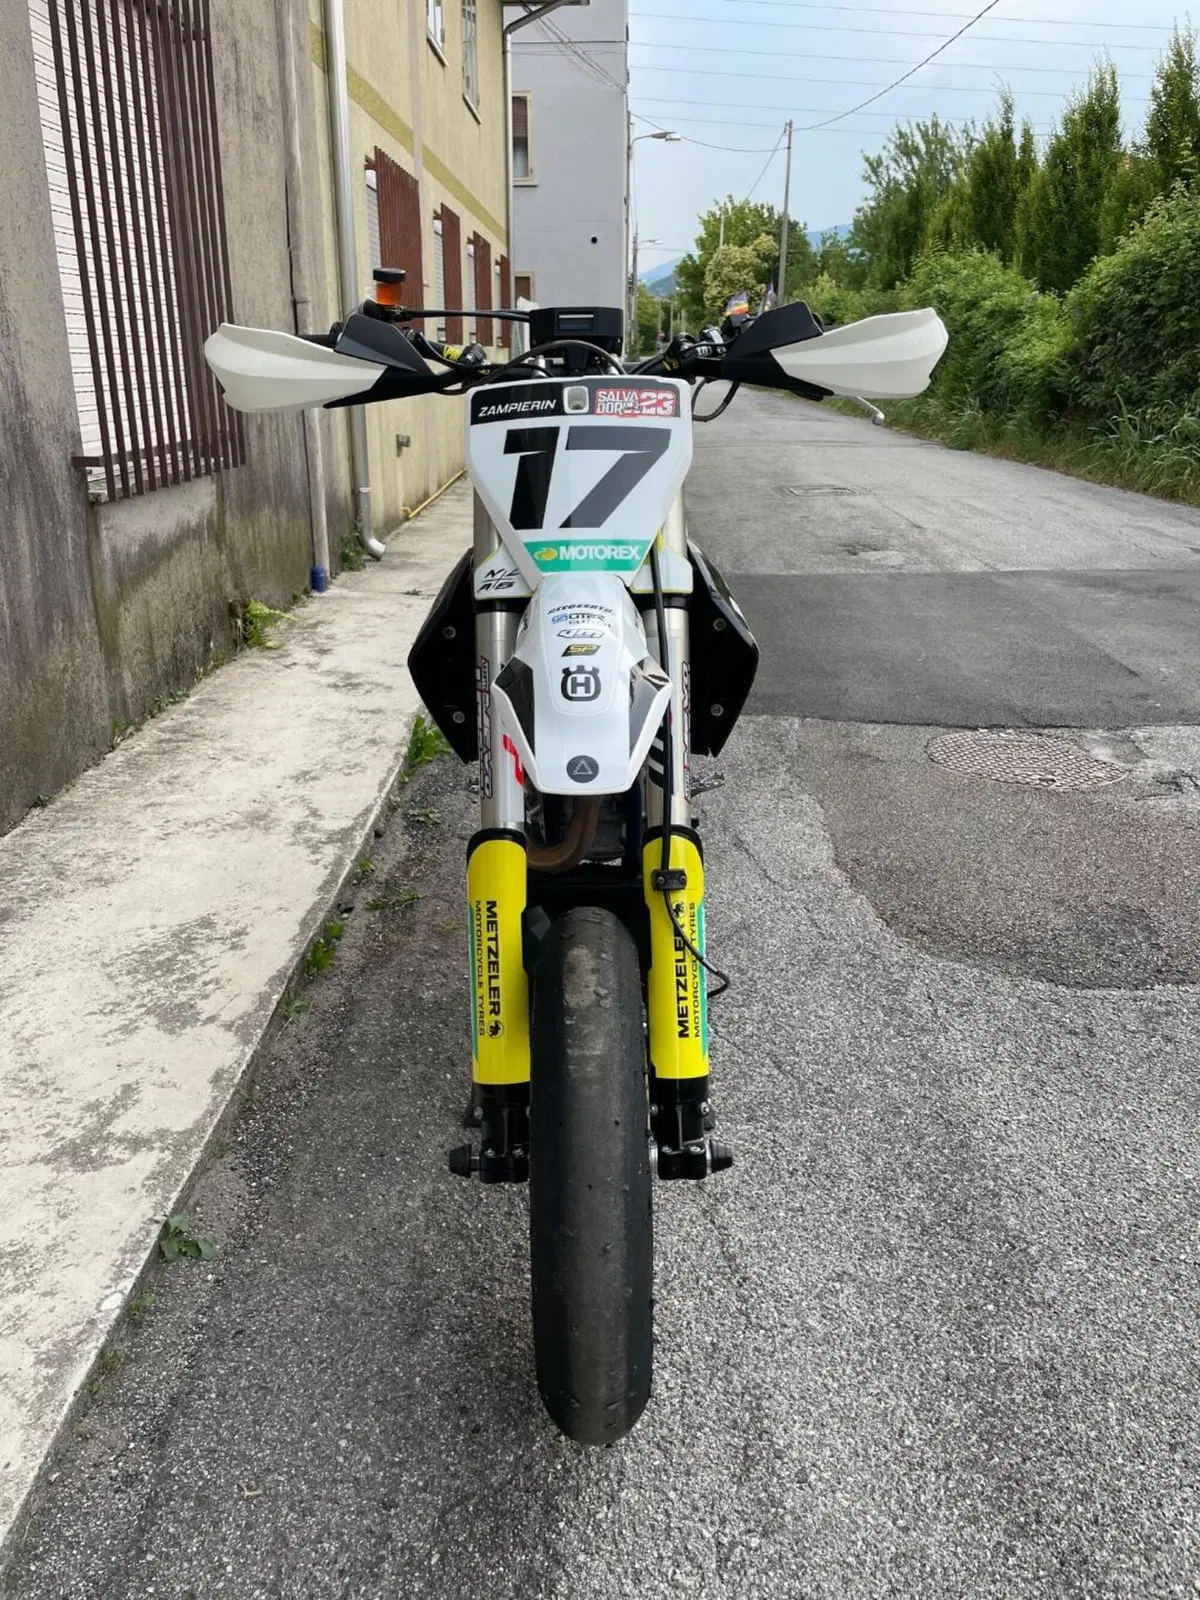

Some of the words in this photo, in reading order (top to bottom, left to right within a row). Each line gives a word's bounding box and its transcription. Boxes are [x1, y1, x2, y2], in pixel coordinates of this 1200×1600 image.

[478, 399, 556, 417] ZAMPIERIN
[598, 390, 638, 402] SALVA
[503, 426, 672, 530] 17
[559, 545, 641, 560] MOTOREX
[475, 900, 485, 989] MOTORCYCLE
[486, 900, 501, 1016] METZELER
